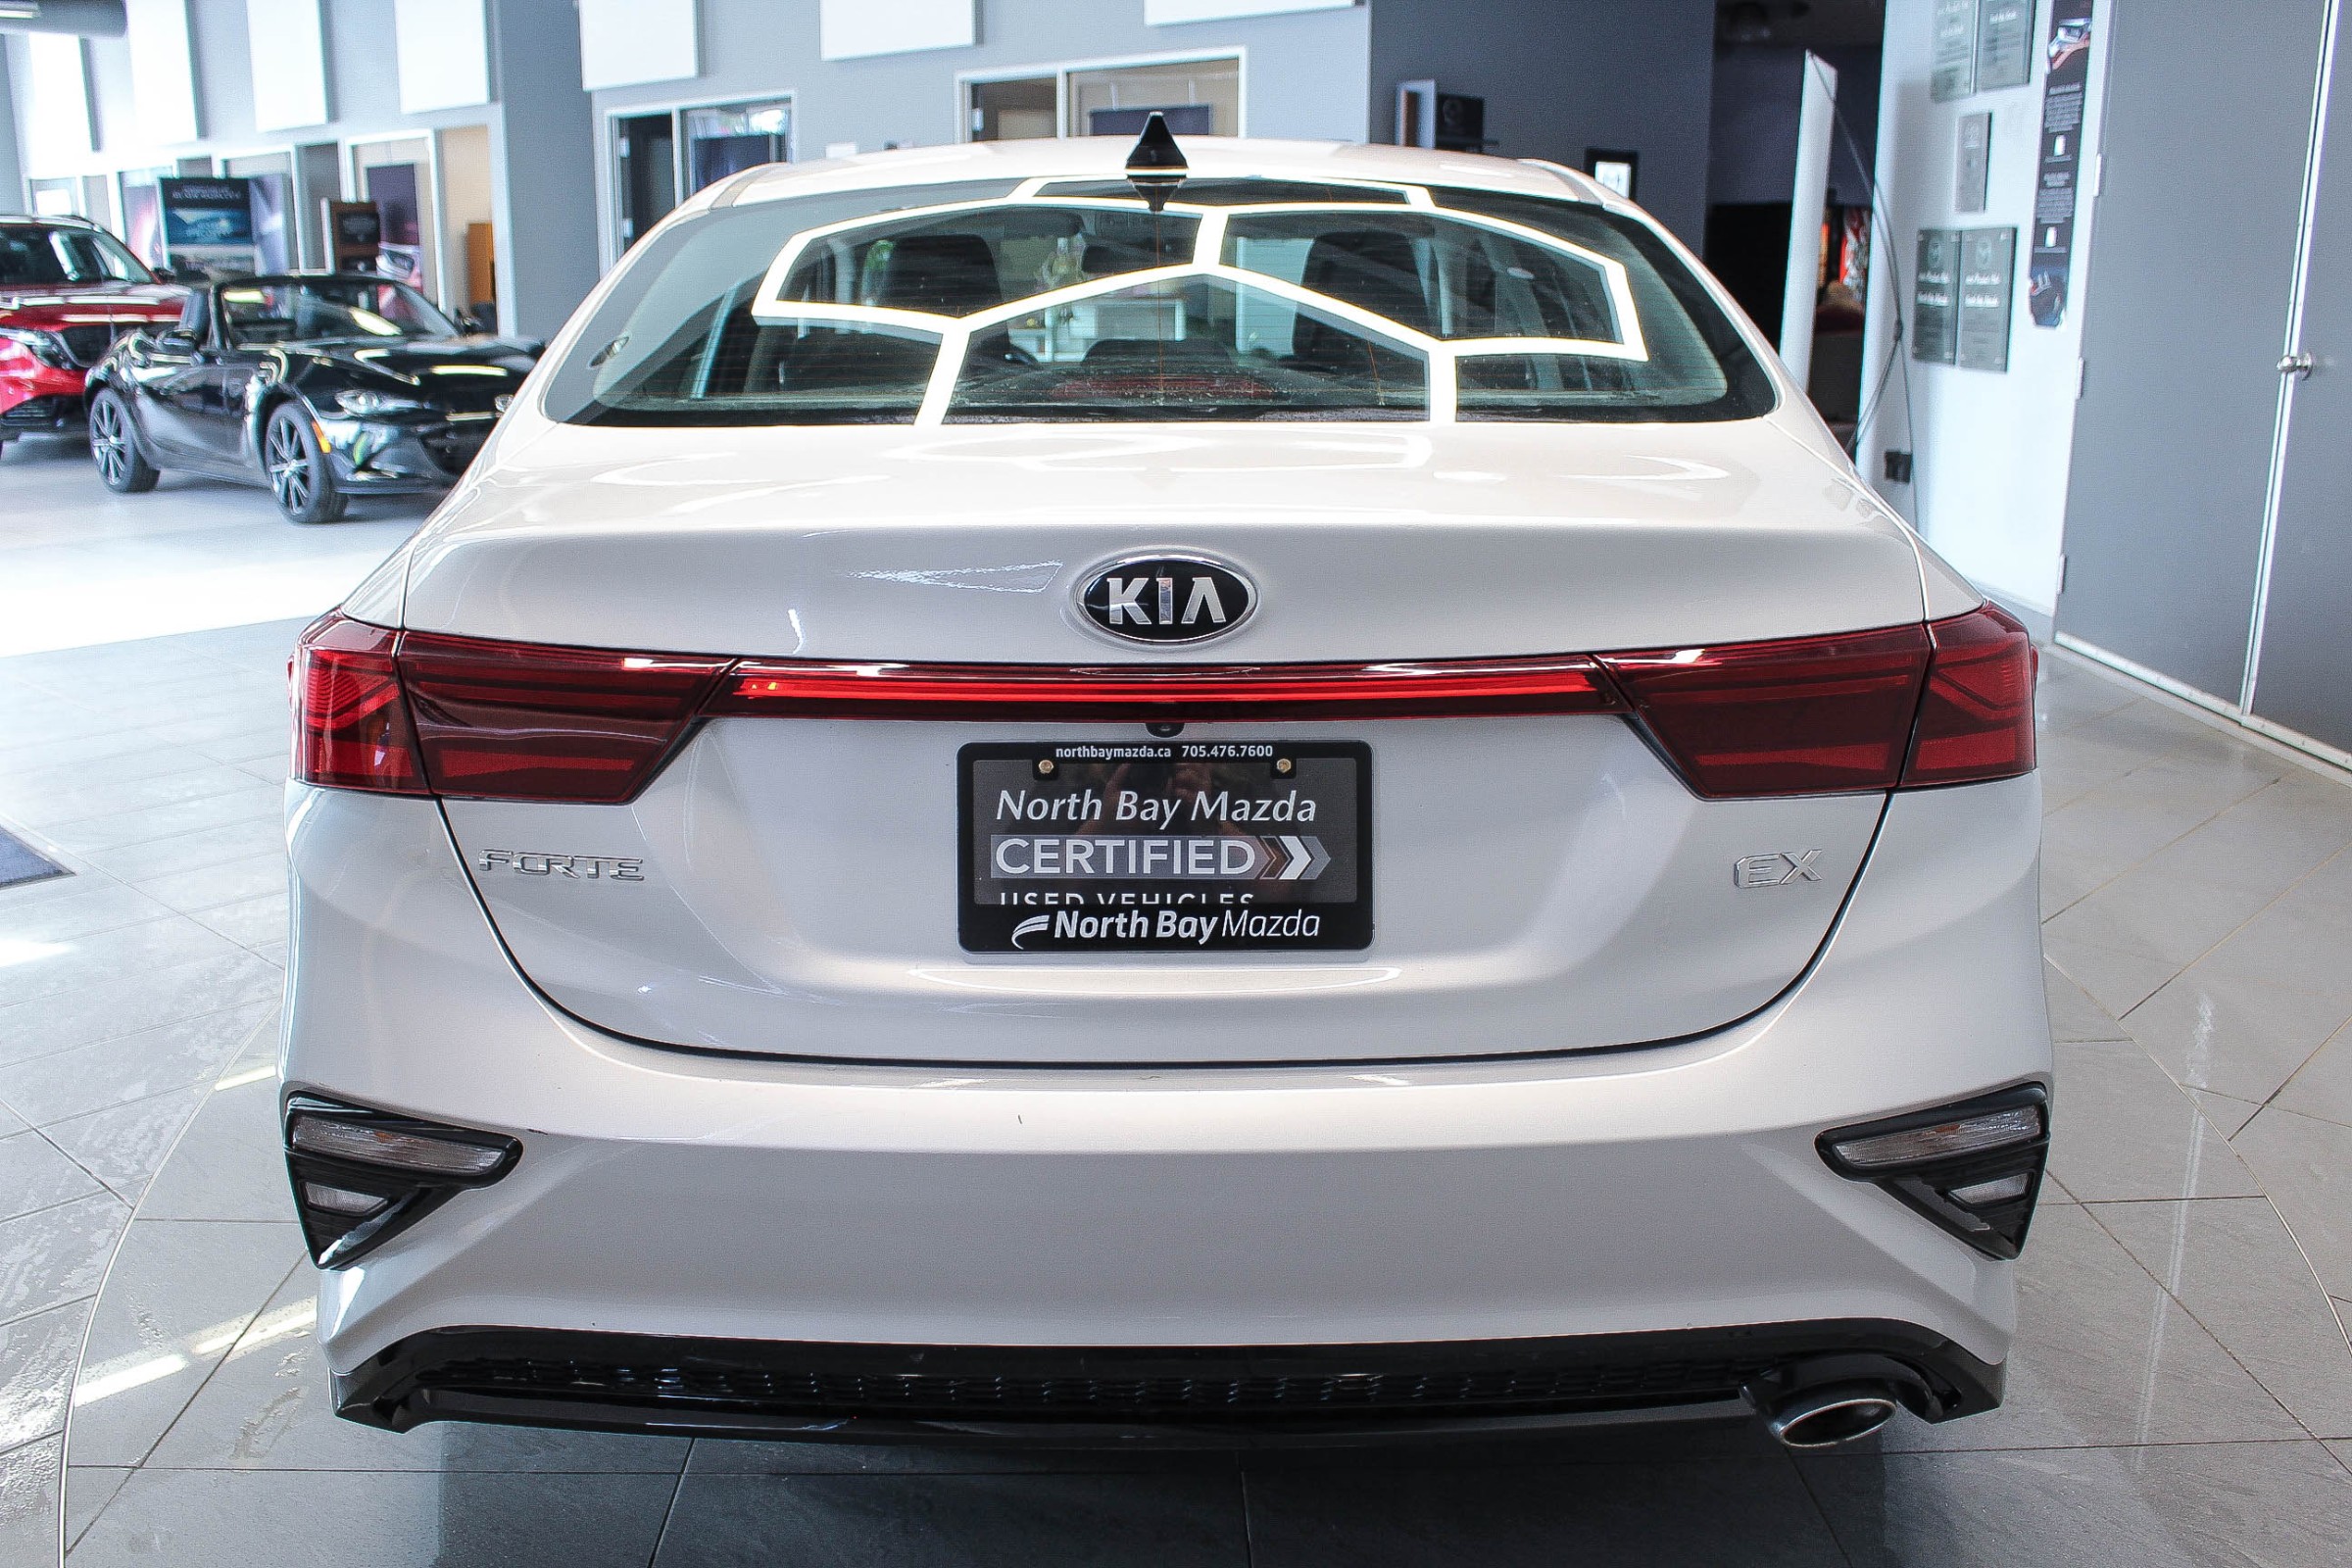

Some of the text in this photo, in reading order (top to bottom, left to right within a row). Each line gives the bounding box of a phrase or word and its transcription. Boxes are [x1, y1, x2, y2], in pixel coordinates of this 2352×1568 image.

[1106, 576, 1227, 624] KIA
[1055, 745, 1273, 760] northbaymazda.ca 705.476.7600
[996, 789, 1316, 830] North Bay Mazda
[478, 849, 645, 881] FORTE
[996, 838, 1255, 875] CERTIFIED
[1733, 849, 1822, 889] EX
[1054, 908, 1321, 946] North Bay Mazda
